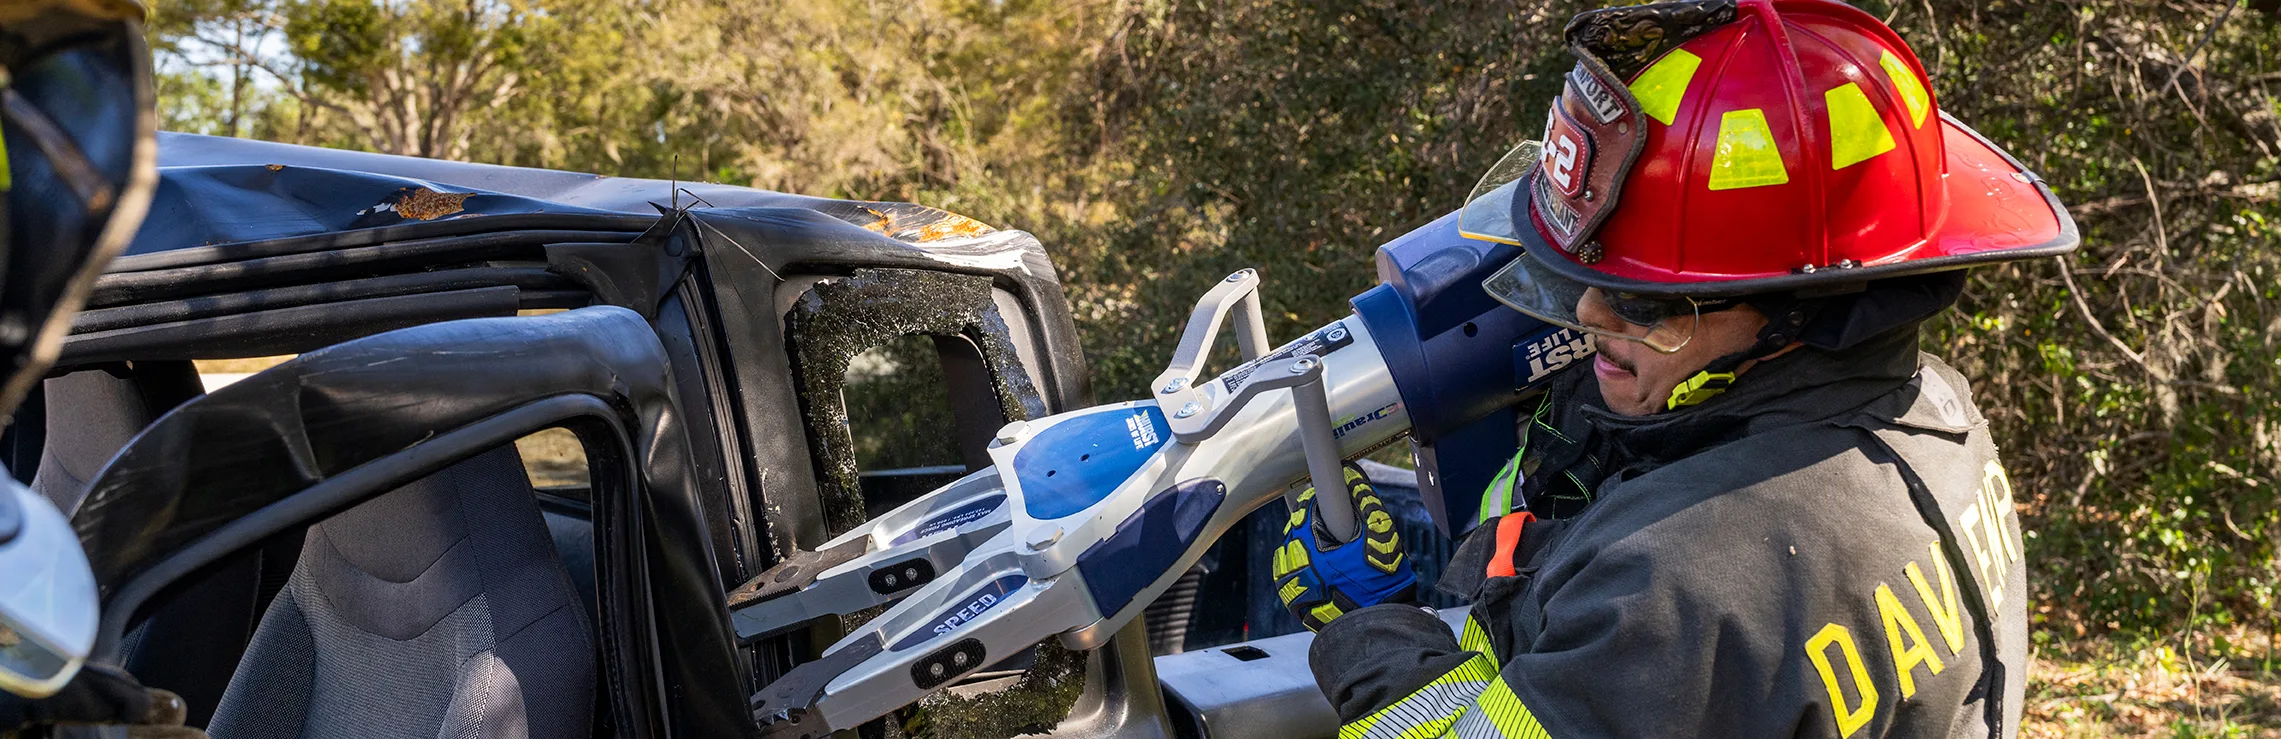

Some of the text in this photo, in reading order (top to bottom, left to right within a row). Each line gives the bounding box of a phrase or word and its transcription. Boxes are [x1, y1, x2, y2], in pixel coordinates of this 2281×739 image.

[1527, 327, 1571, 358] LIFE
[1527, 331, 1598, 383] RST
[1134, 411, 1160, 447] HURST
[933, 593, 997, 636] SPEED
